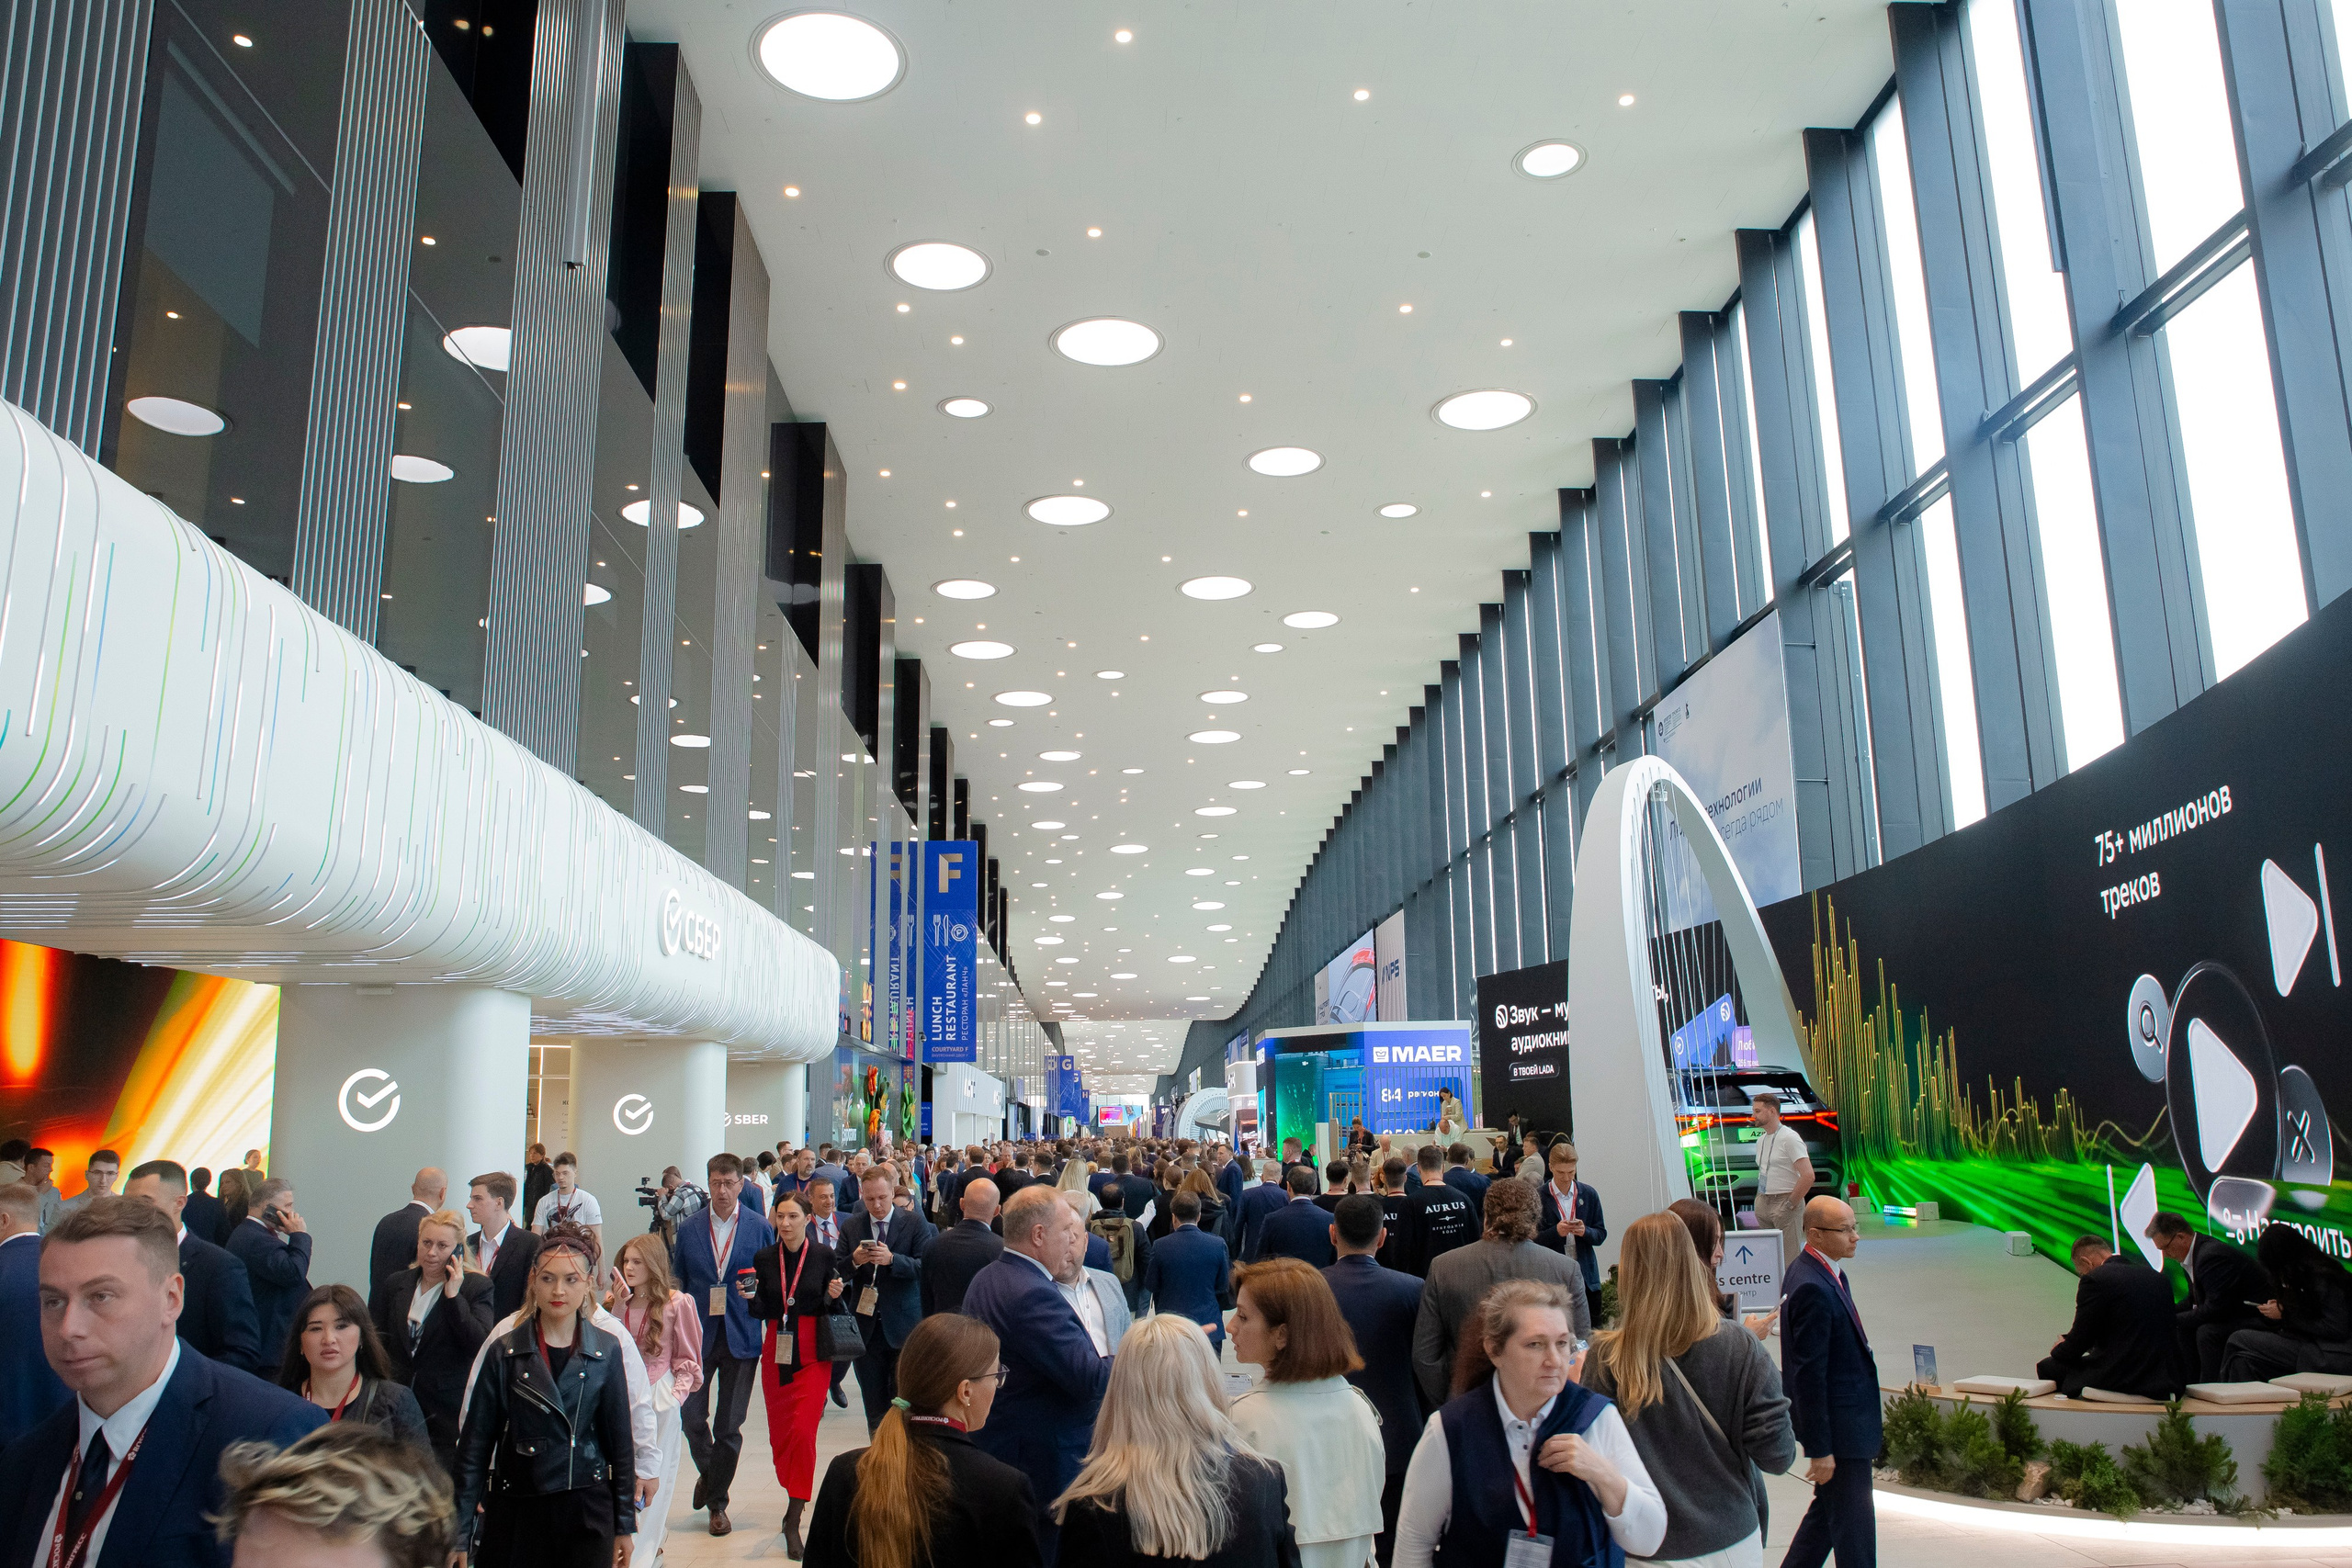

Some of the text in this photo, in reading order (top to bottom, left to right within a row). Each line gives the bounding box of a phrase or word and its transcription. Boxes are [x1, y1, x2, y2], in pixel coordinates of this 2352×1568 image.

[1705, 777, 1762, 819] ехнологии
[1718, 816, 1747, 841] сегда
[1749, 798, 1783, 832] рядом
[2095, 785, 2233, 867] 75+ миллионов
[939, 853, 963, 893] F
[2100, 872, 2161, 919] треков
[684, 909, 721, 961] СБЕР
[945, 955, 956, 1041] RESTAURANT
[1510, 1005, 1539, 1025] Звук
[1555, 1001, 1569, 1021] му
[932, 997, 943, 1041] LUNCH
[1062, 1059, 1072, 1071] G
[1392, 1045, 1462, 1062] MAER
[1513, 1064, 1555, 1077] В ТВОЕЙ LADA
[1381, 1088, 1441, 1102] 84 регион
[734, 1114, 769, 1124] SBER
[1425, 1201, 1466, 1214] AURUS
[1729, 1273, 1771, 1286] centre
